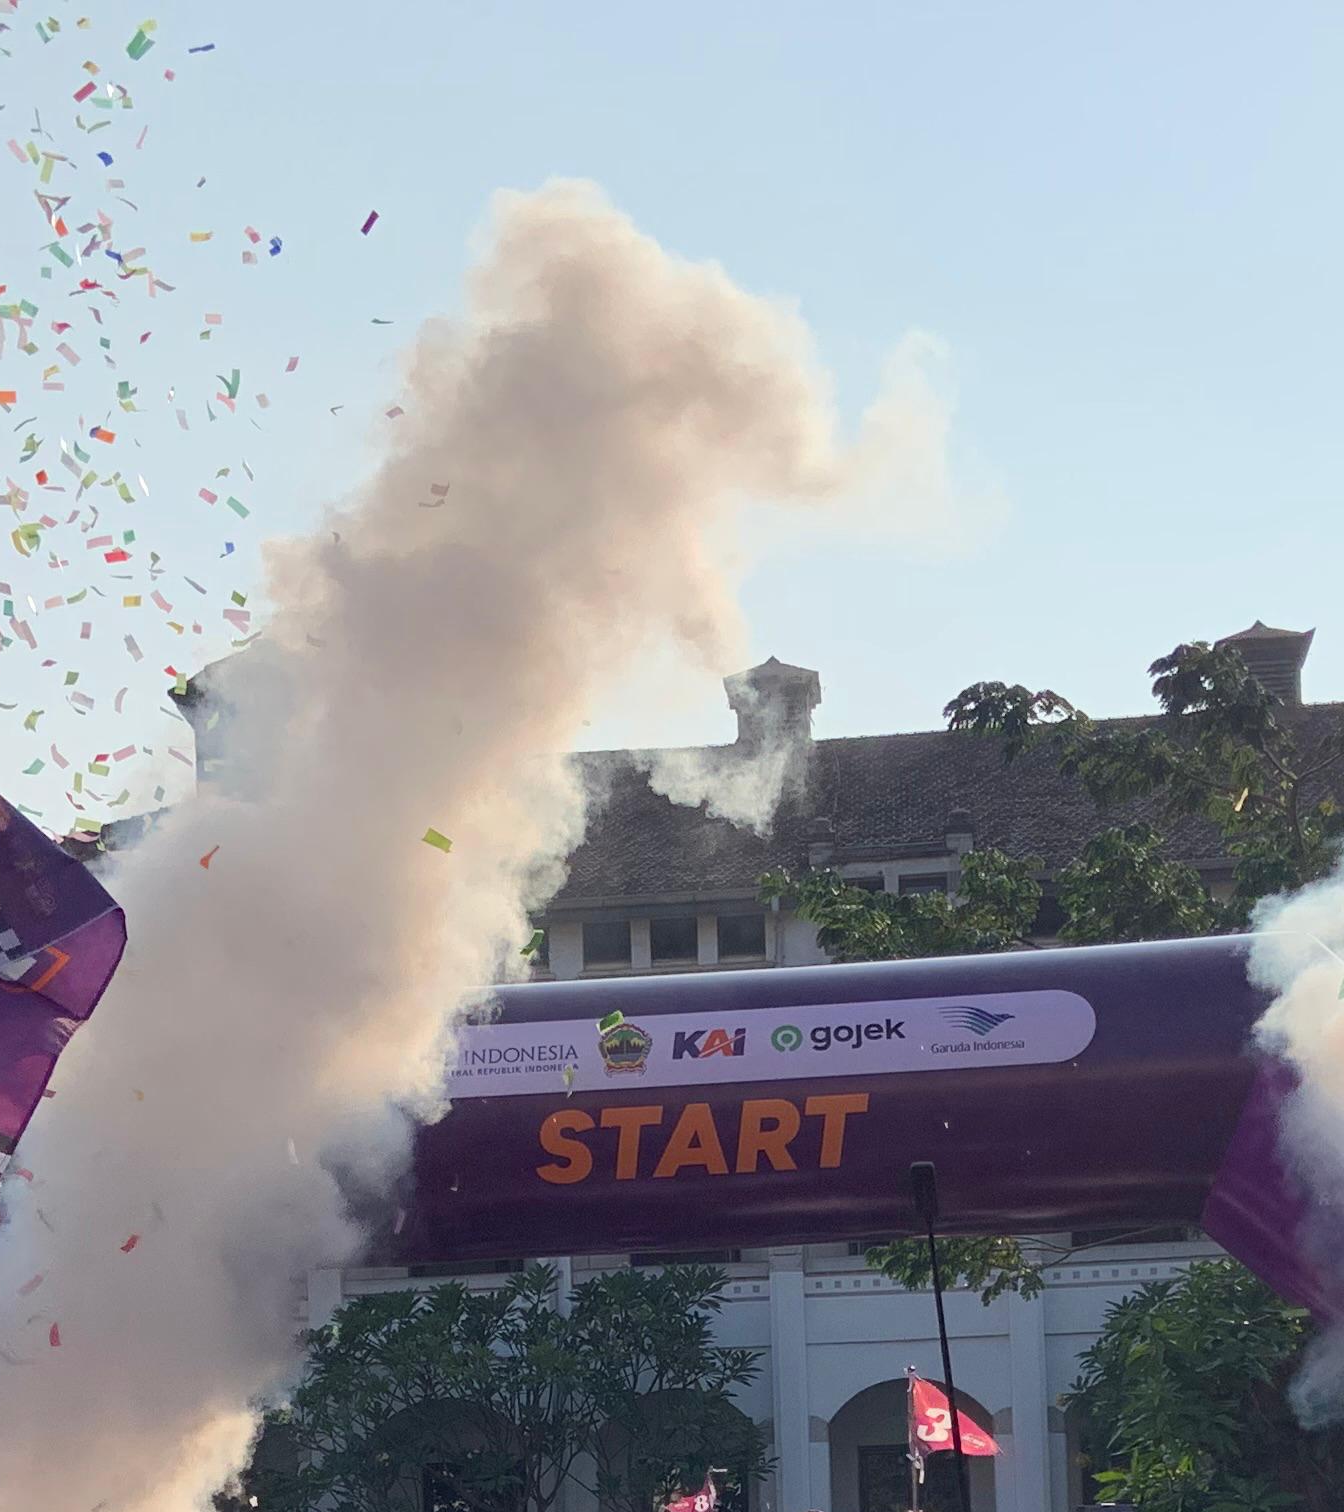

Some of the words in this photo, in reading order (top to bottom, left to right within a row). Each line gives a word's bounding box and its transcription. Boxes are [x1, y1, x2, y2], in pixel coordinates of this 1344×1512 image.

[671, 1028, 747, 1061] KAI
[810, 1018, 906, 1051] gojek
[931, 1039, 971, 1055] Garuda
[973, 1036, 1026, 1052] Indonesia
[477, 1065, 523, 1077] REPUBLIK
[535, 1093, 869, 1185] START
[694, 1494, 709, 1512] 8
